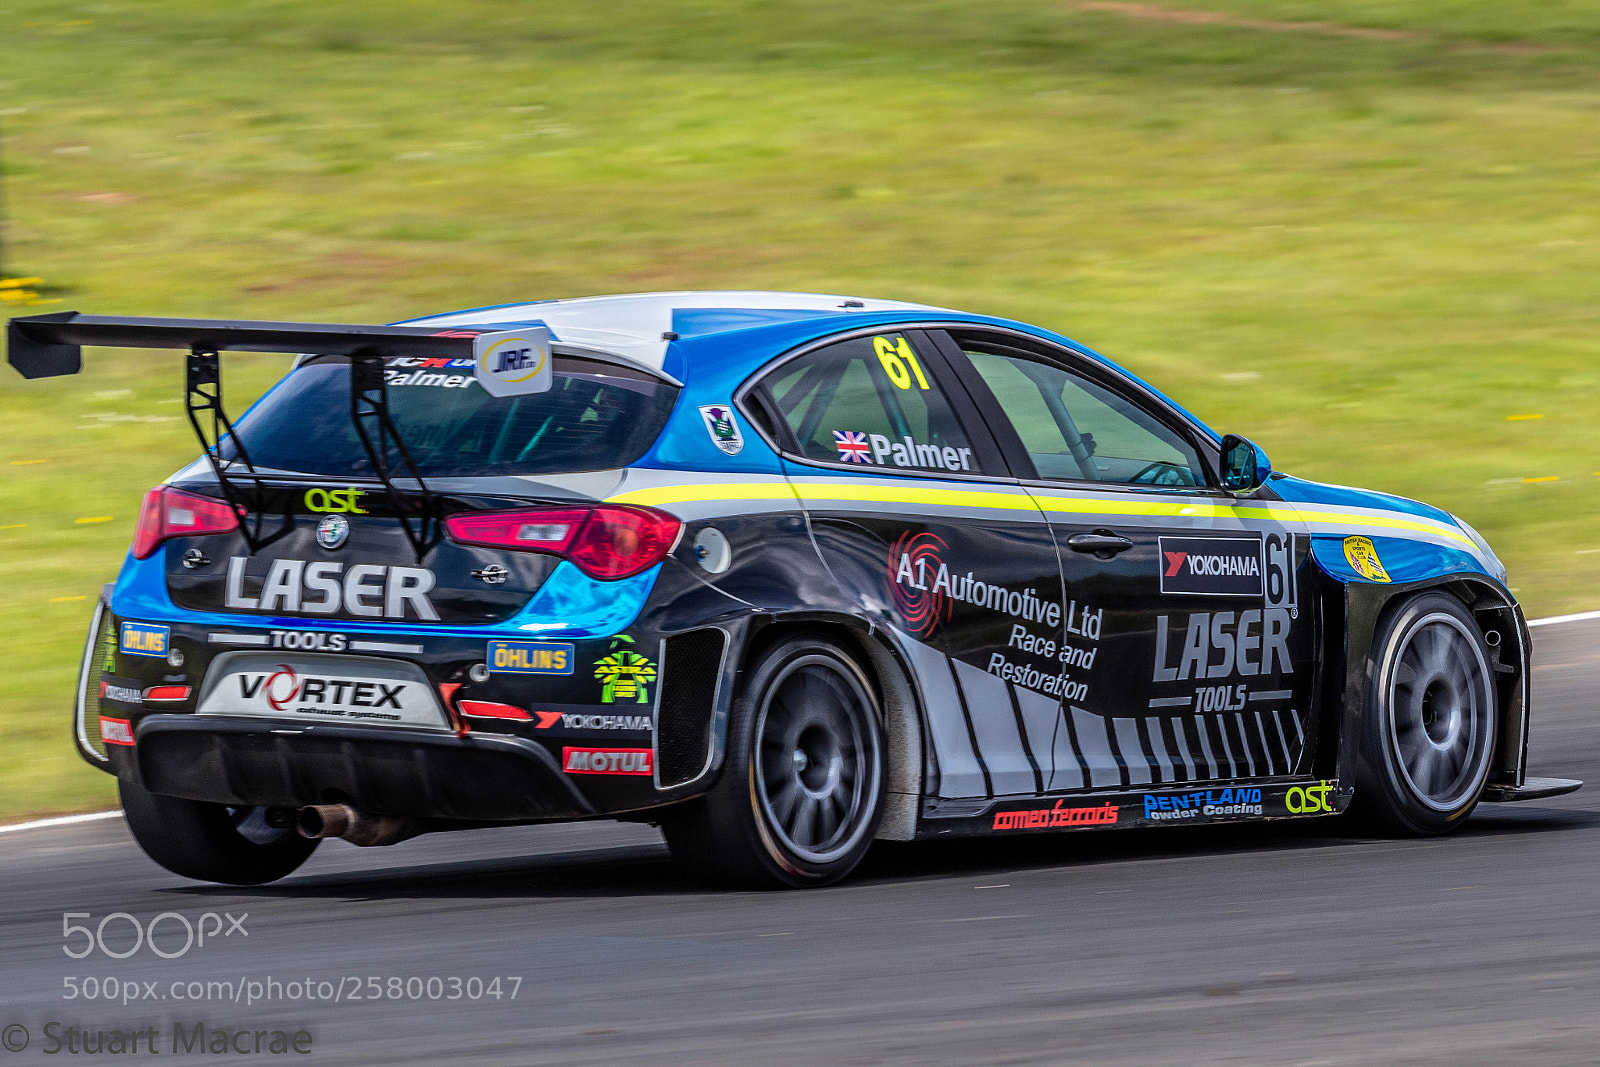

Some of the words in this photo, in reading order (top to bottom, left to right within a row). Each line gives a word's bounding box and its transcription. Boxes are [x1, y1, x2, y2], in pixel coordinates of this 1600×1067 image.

[873, 336, 930, 389] 61
[869, 434, 972, 470] Palmer
[1187, 555, 1260, 576] YOKOHAMA
[1265, 533, 1296, 605] 61
[224, 556, 441, 621] LASER
[896, 553, 928, 591] A1
[932, 563, 1061, 628] Automotive
[1066, 600, 1103, 641] Ltd
[270, 630, 347, 651] TOOLS
[494, 643, 568, 670] ÖHLINS
[1008, 624, 1056, 658] Race
[1058, 645, 1098, 670] and
[1153, 607, 1294, 682] LASER
[239, 664, 406, 711] VORTEX
[988, 652, 1089, 702] Restoration
[1195, 684, 1247, 713] TOOLS
[561, 713, 653, 730] YOKOHAMA
[566, 751, 651, 772] MOTUL
[1143, 788, 1262, 819] PENTLAND
[1203, 802, 1263, 815] Coating
